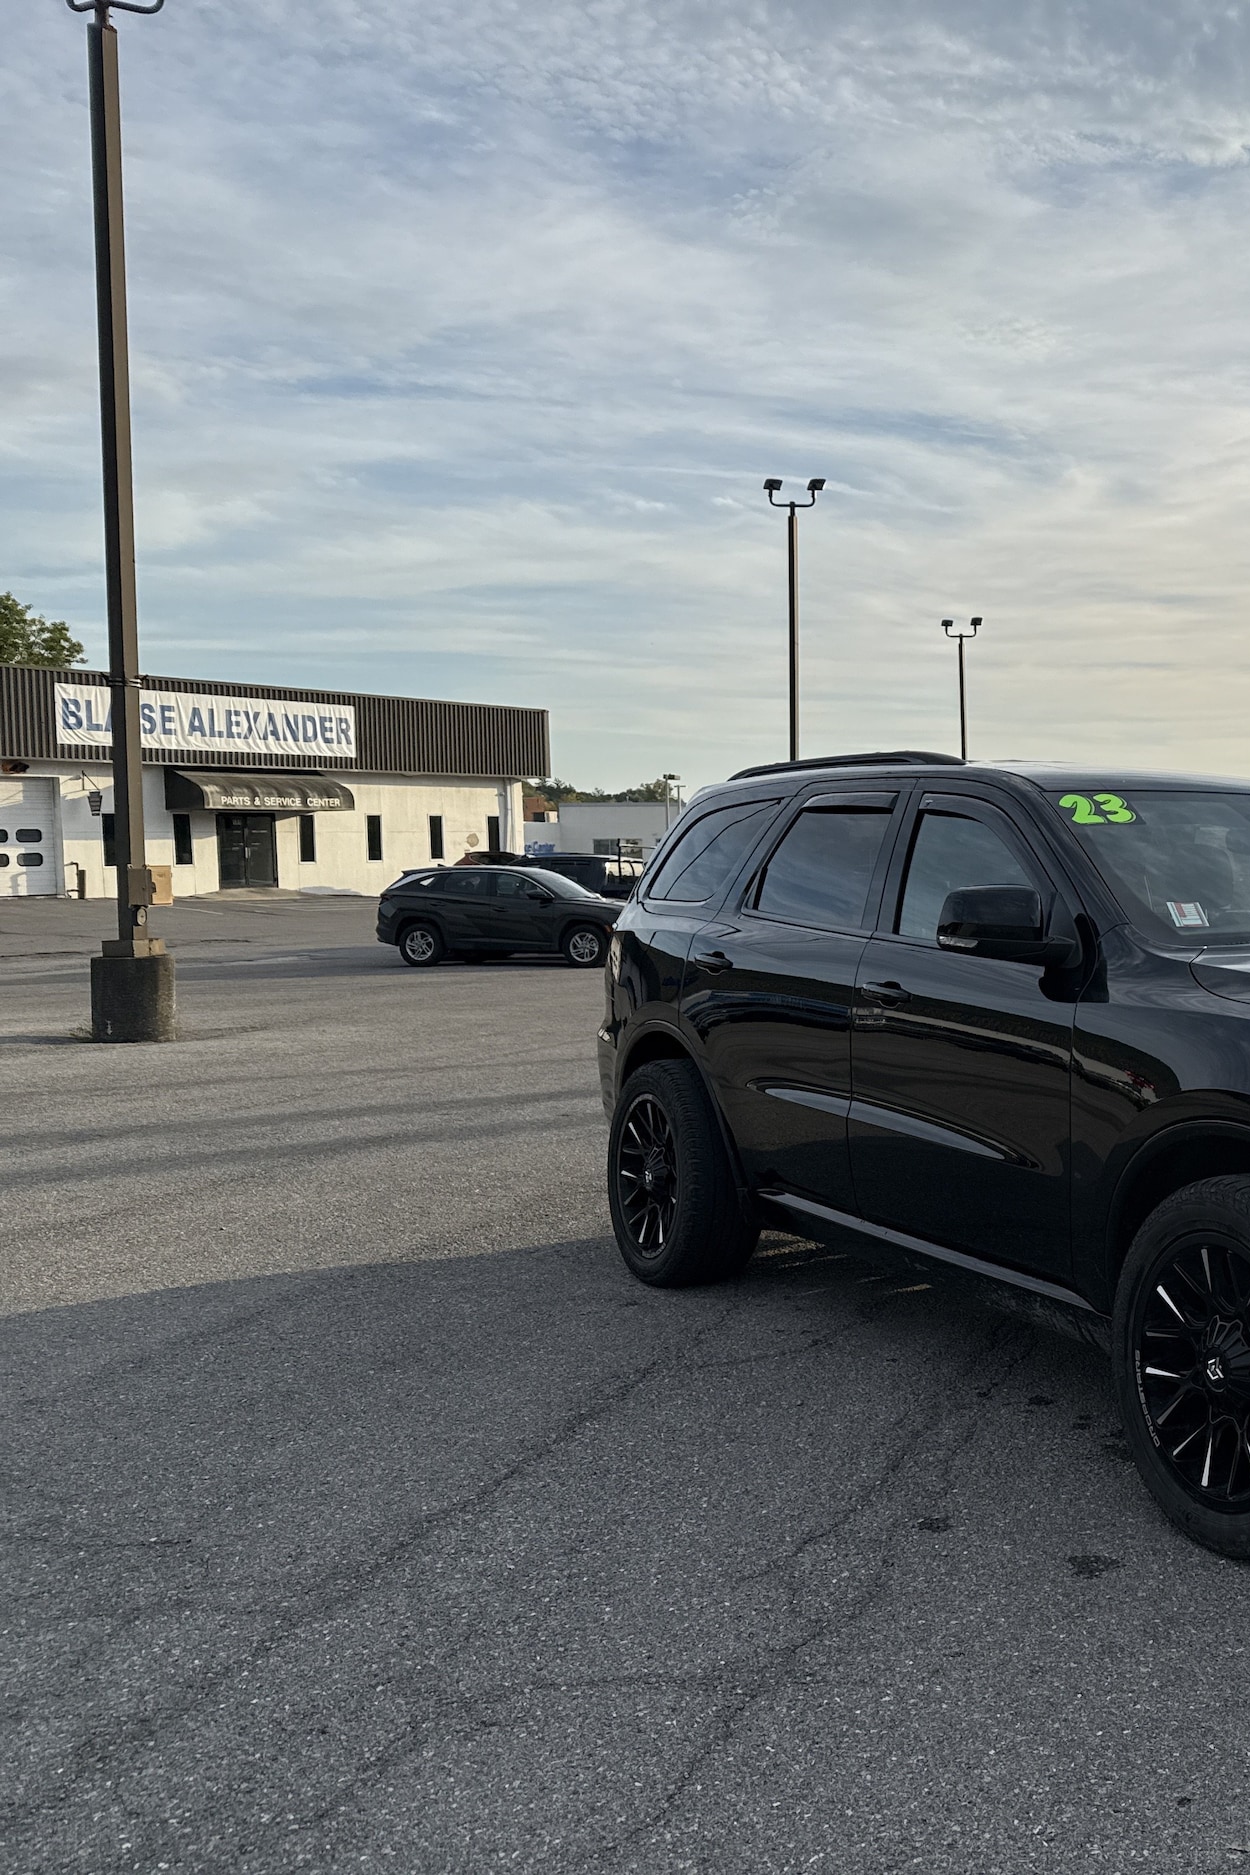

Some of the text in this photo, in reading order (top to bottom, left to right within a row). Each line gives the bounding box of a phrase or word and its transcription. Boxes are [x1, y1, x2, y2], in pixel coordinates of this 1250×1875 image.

[61, 698, 353, 745] BLSE ALEXANDER
[221, 796, 341, 807] PARTS & SERVICE CENTER
[1059, 793, 1136, 824] 23
[1135, 1349, 1160, 1447] DROPSTARS
